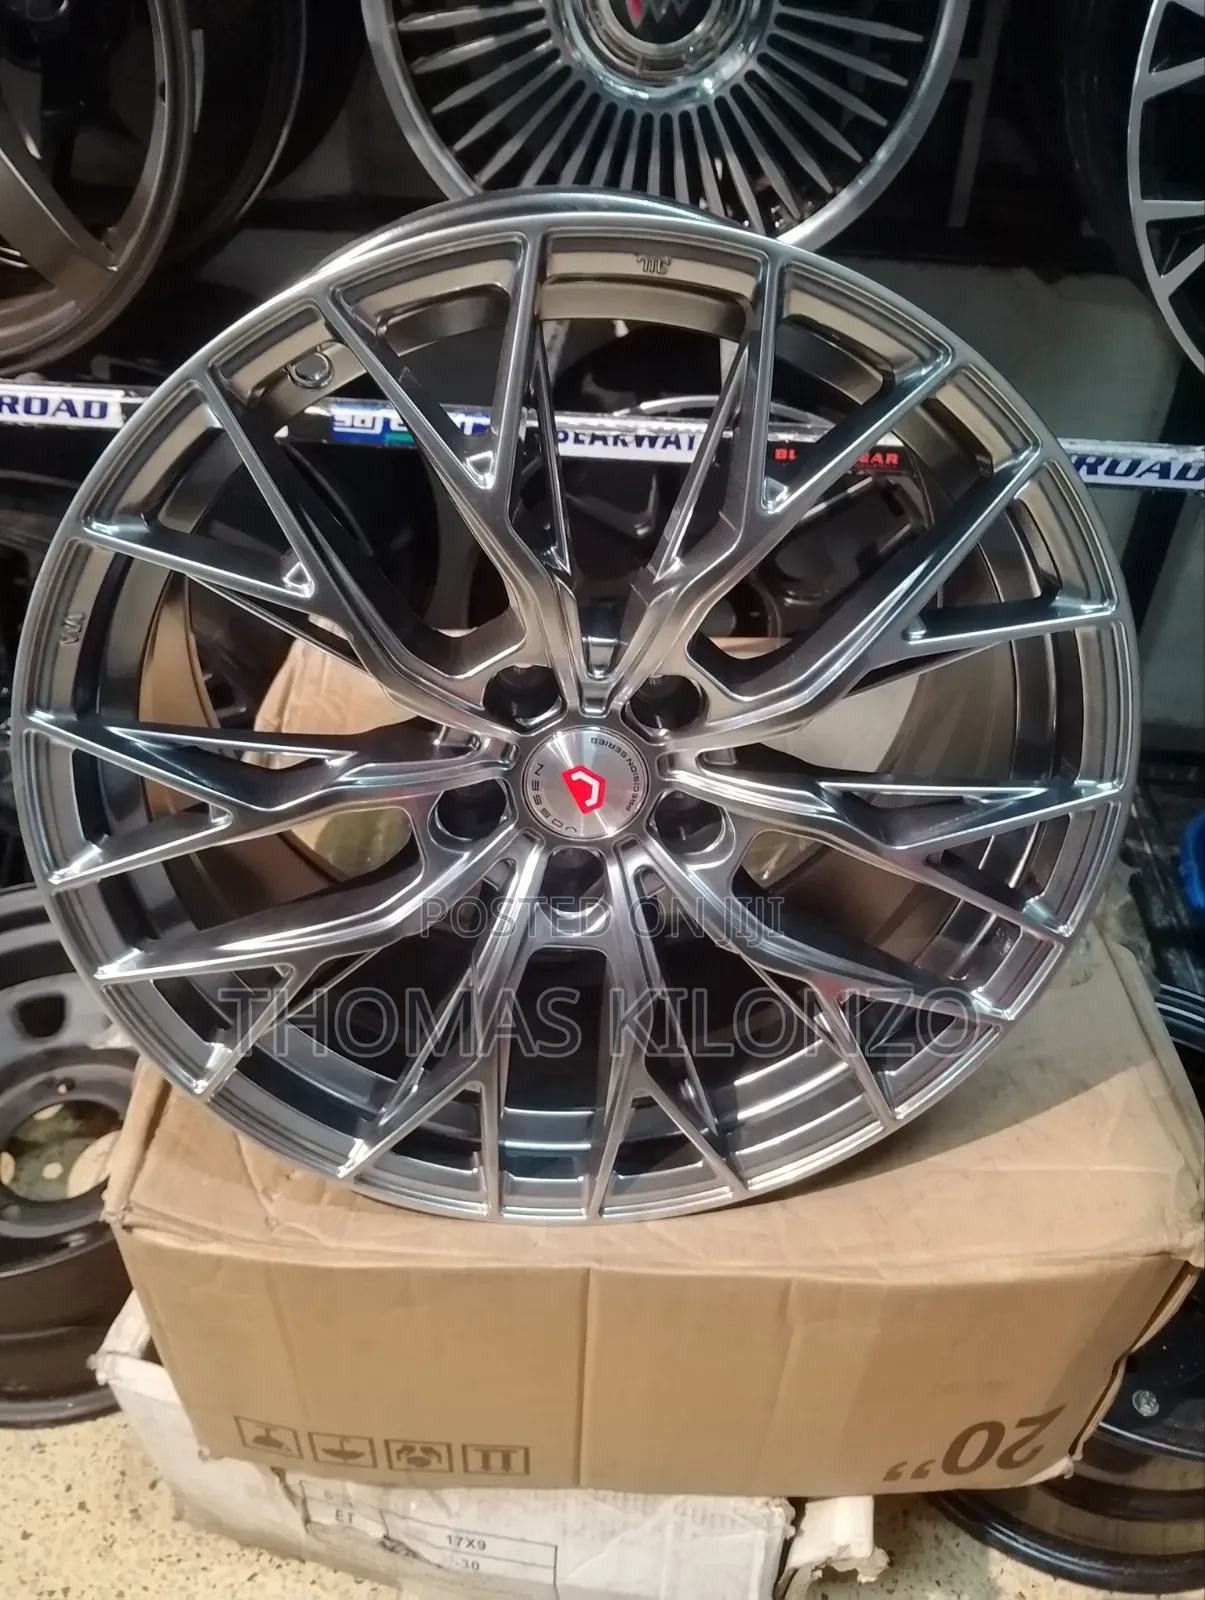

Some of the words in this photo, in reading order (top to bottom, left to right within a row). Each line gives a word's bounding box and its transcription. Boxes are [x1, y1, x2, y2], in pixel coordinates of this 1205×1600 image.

[0, 395, 109, 419] ROAD
[531, 762, 578, 833] VOSSEN
[446, 1533, 487, 1551] 17X9
